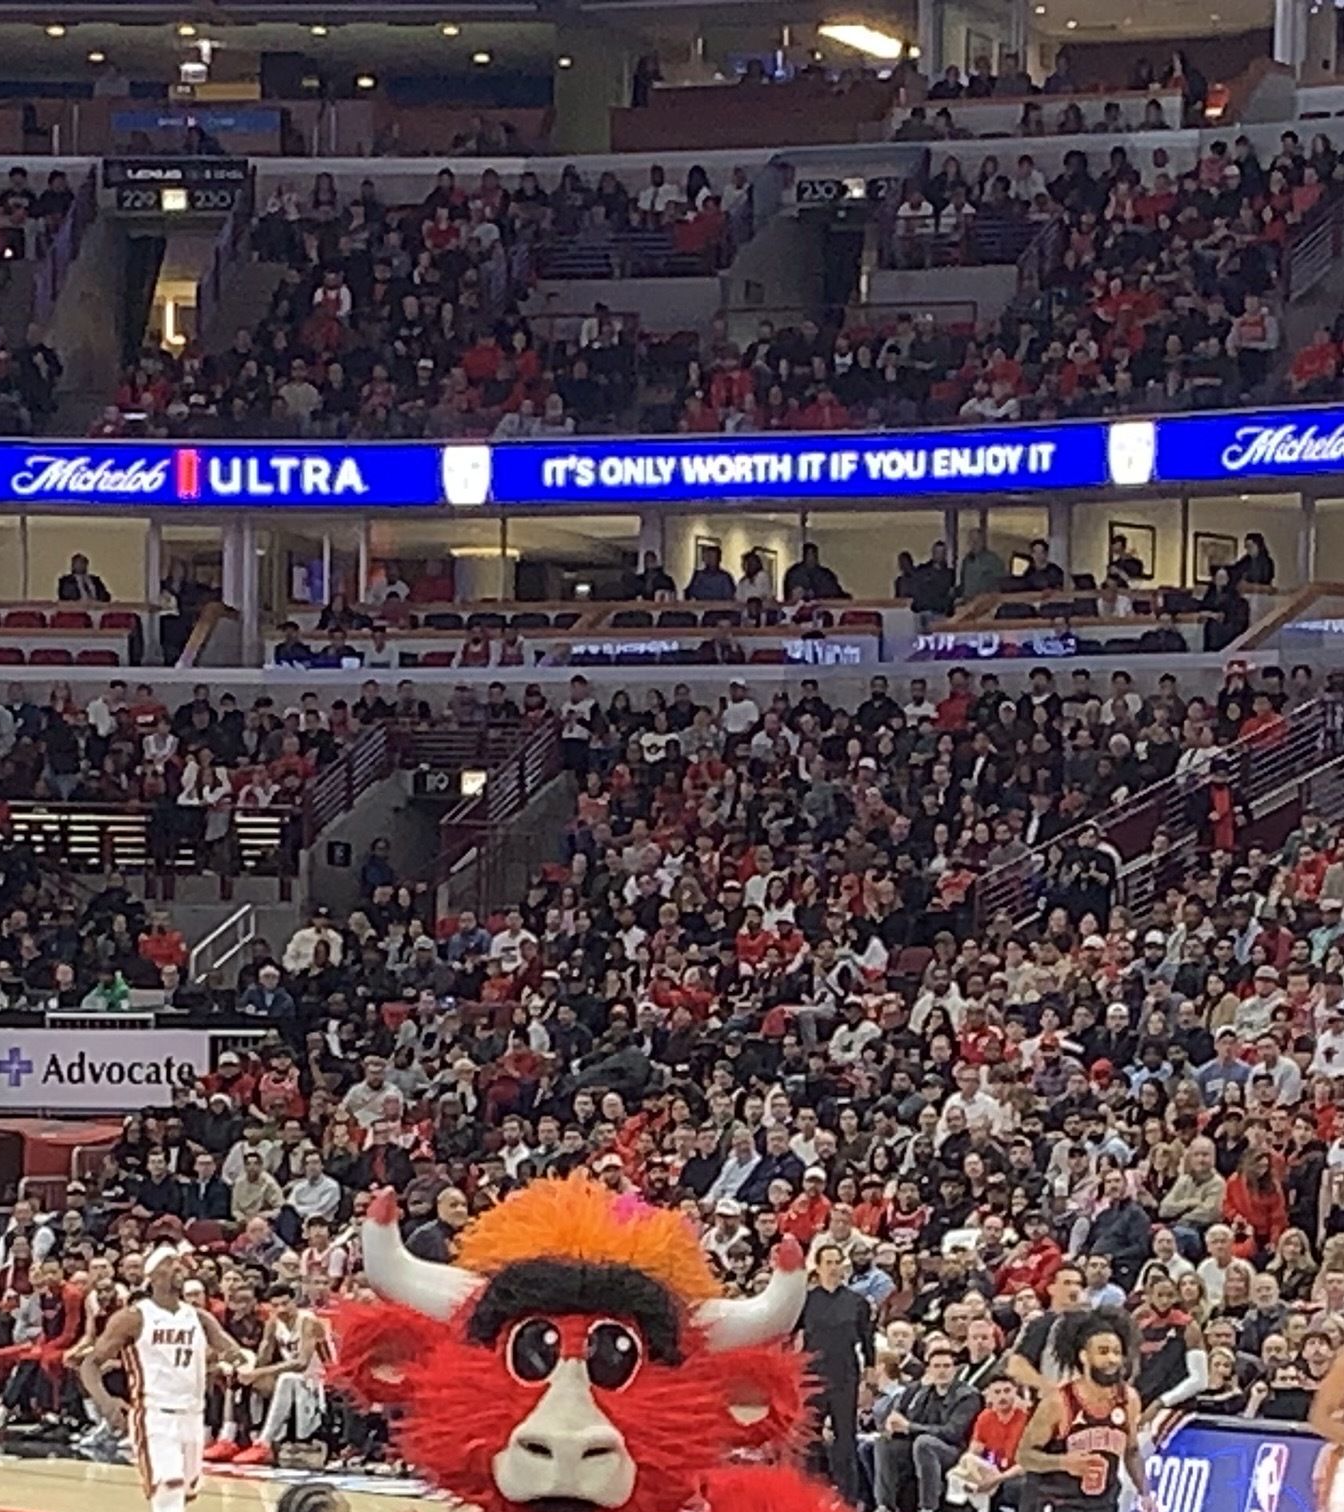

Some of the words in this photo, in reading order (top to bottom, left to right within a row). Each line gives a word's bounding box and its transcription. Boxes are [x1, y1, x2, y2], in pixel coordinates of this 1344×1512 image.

[11, 456, 171, 494] Michelob
[210, 457, 369, 494] ULTRA
[543, 455, 595, 487] IT'S
[599, 456, 677, 486] ONLY
[681, 453, 792, 485] WORTH
[798, 453, 826, 482] IT
[829, 452, 858, 481] IF
[864, 450, 927, 480] YOU
[932, 446, 1024, 477] ENJOY
[1028, 442, 1056, 473] IT
[42, 1051, 194, 1084] Advocate
[152, 1325, 197, 1346] HEAT
